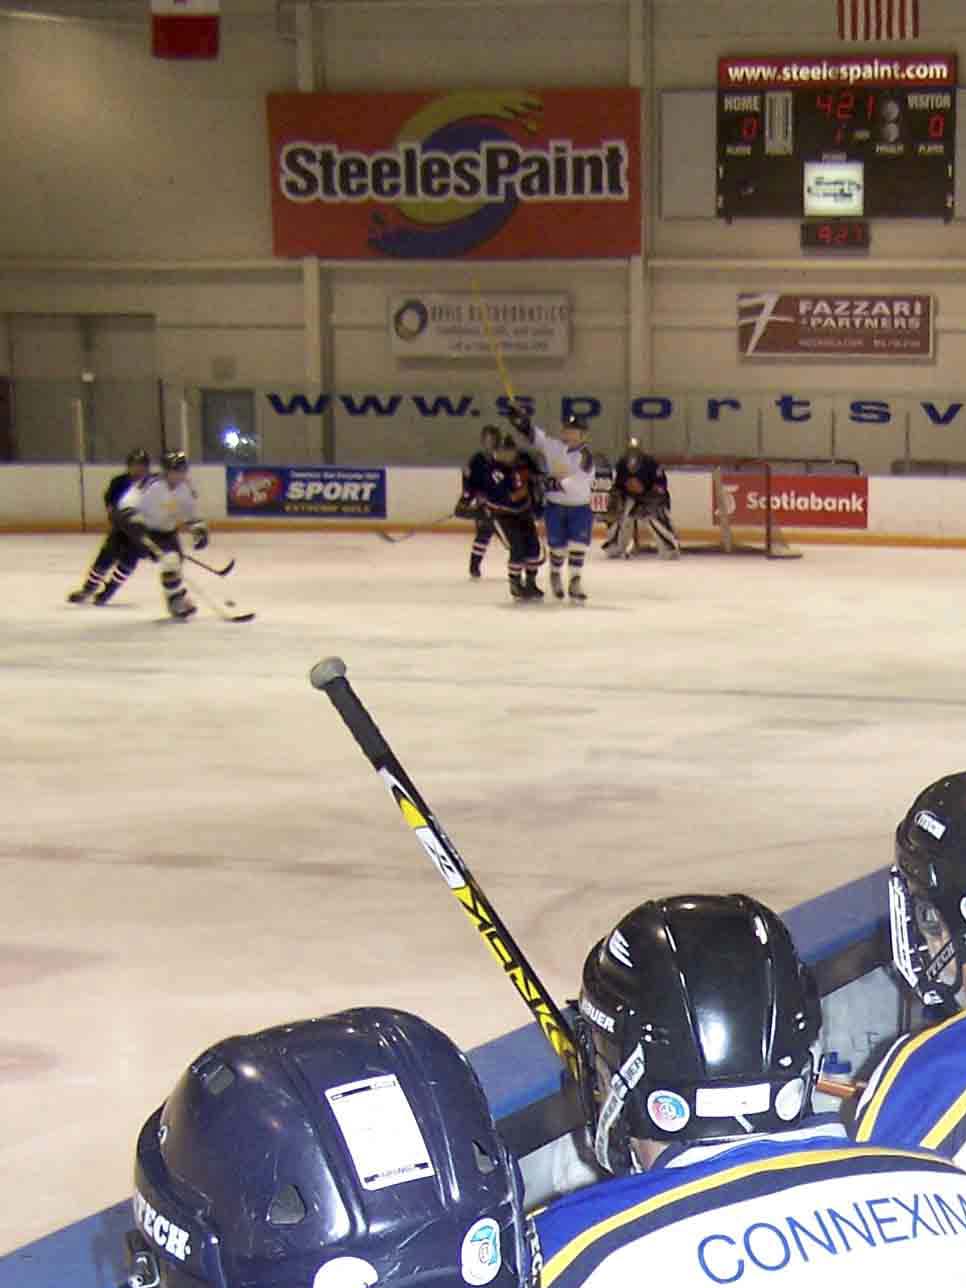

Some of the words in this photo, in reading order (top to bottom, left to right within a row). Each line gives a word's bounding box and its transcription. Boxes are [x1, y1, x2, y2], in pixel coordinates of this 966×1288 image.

[727, 59, 948, 84] www.steelespaint.com
[282, 142, 629, 202] SteelesPaint
[798, 301, 922, 316] FAZZARI
[285, 481, 376, 501] SPORT
[746, 490, 865, 513] Scotiabank
